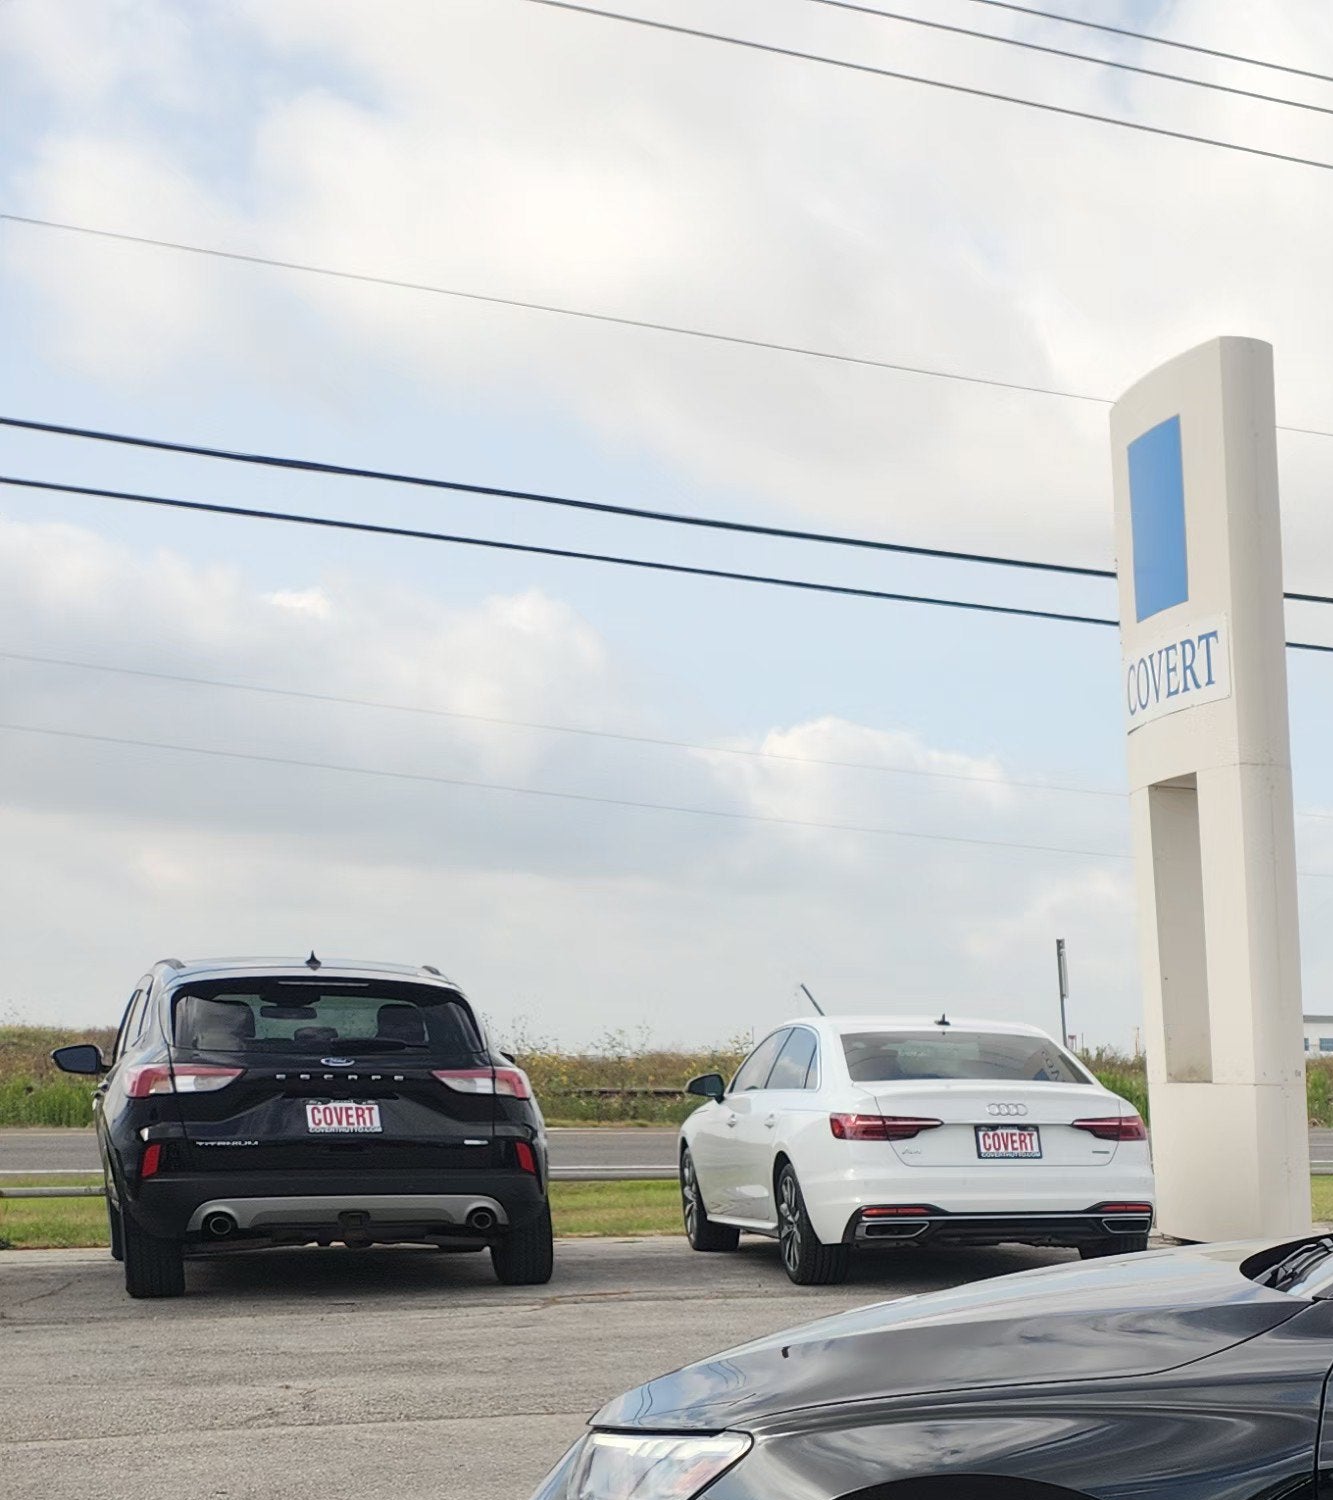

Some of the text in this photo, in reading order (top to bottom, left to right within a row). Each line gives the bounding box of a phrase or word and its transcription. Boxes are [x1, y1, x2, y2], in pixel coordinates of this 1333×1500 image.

[1127, 630, 1219, 716] COVERT
[311, 1106, 375, 1127] COVERT
[982, 1131, 1035, 1152] COVERT
